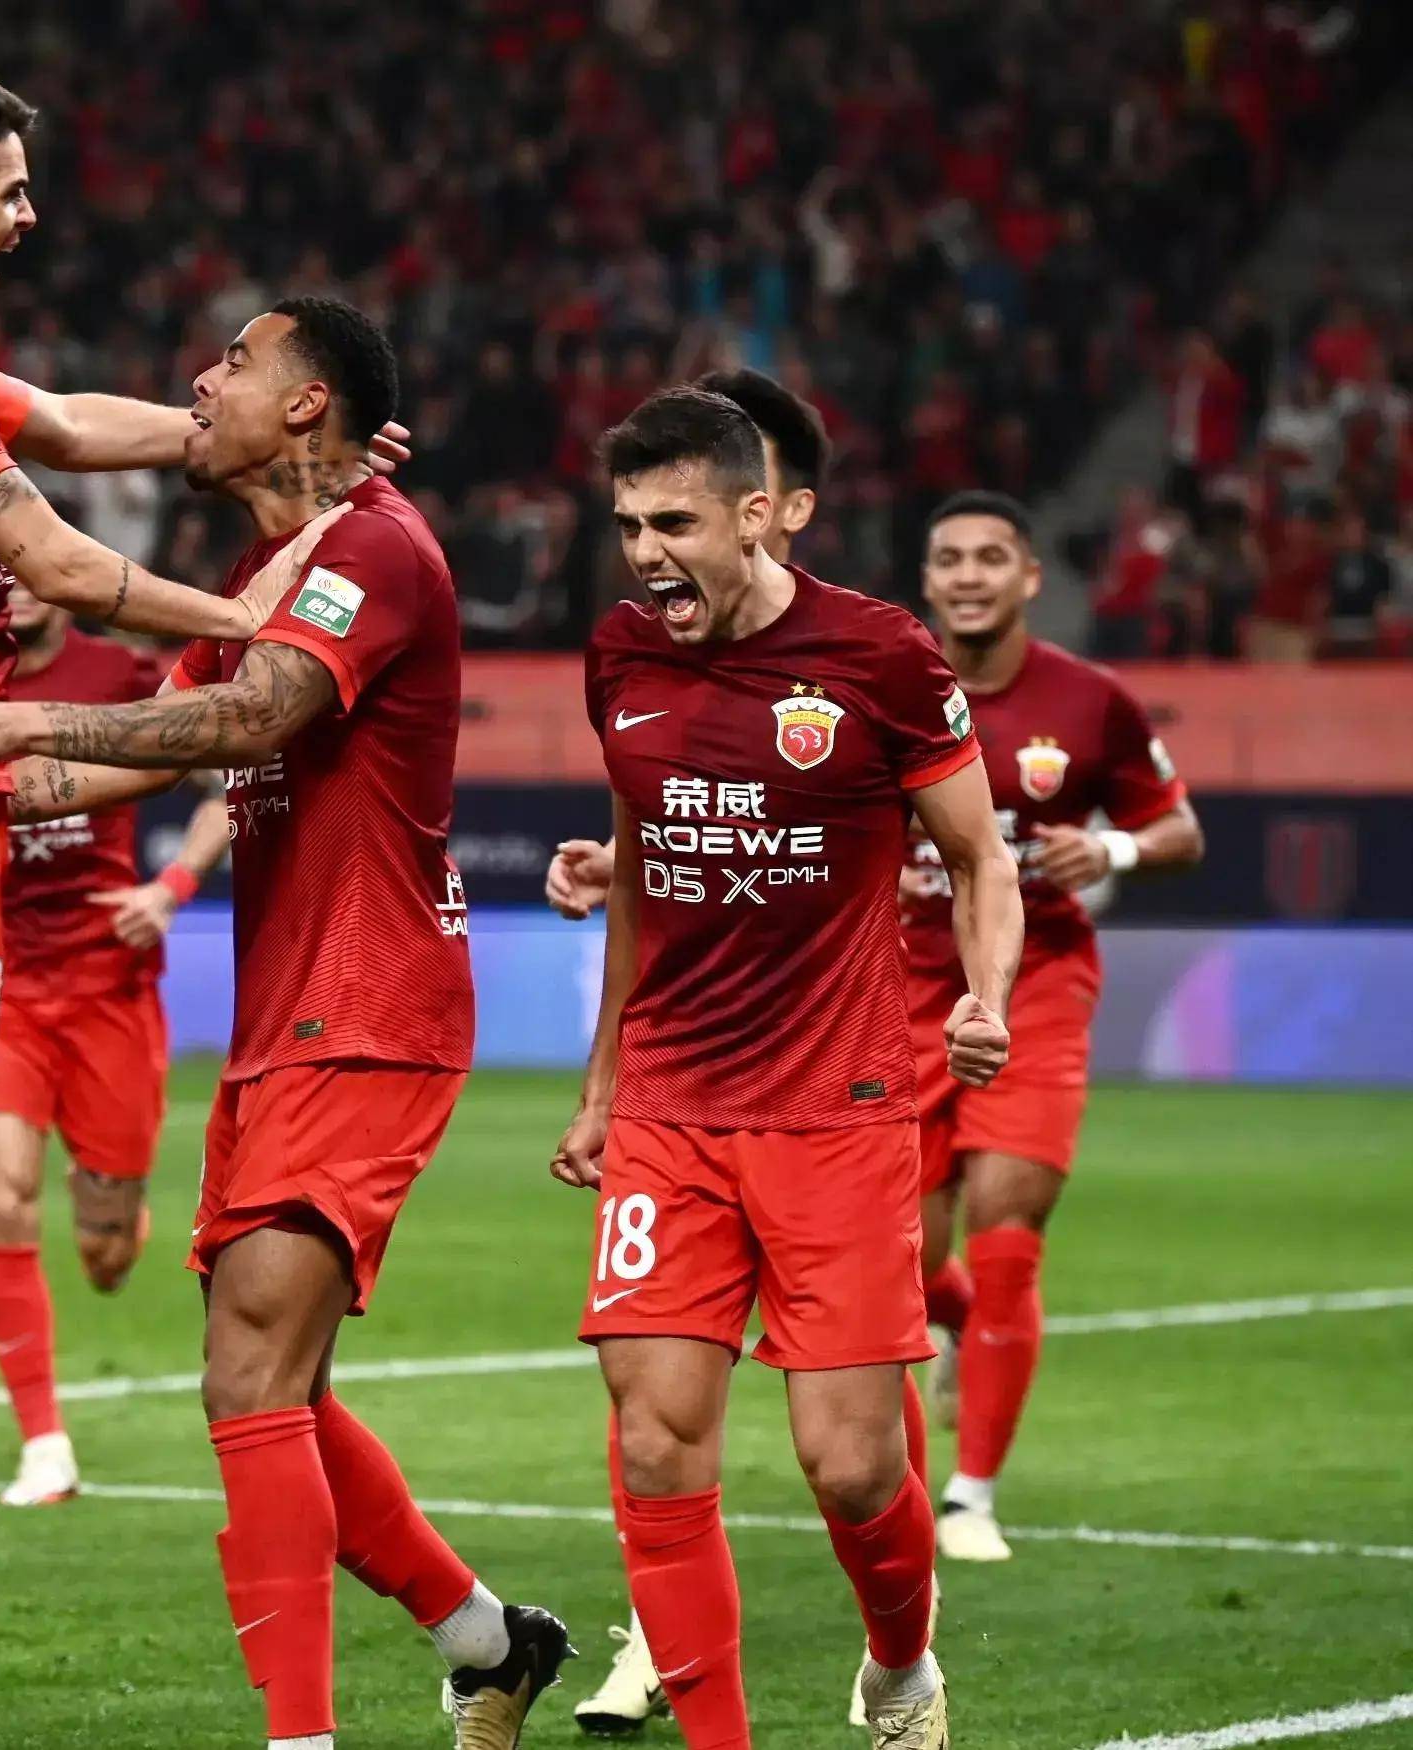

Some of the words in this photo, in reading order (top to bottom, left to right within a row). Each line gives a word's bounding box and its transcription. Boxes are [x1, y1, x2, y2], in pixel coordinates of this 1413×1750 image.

[662, 777, 767, 819] 荣威
[640, 821, 824, 857] ROEWE
[643, 858, 706, 903] D5
[720, 868, 768, 905] X
[767, 865, 830, 886] DMH
[596, 1192, 656, 1282] 18
